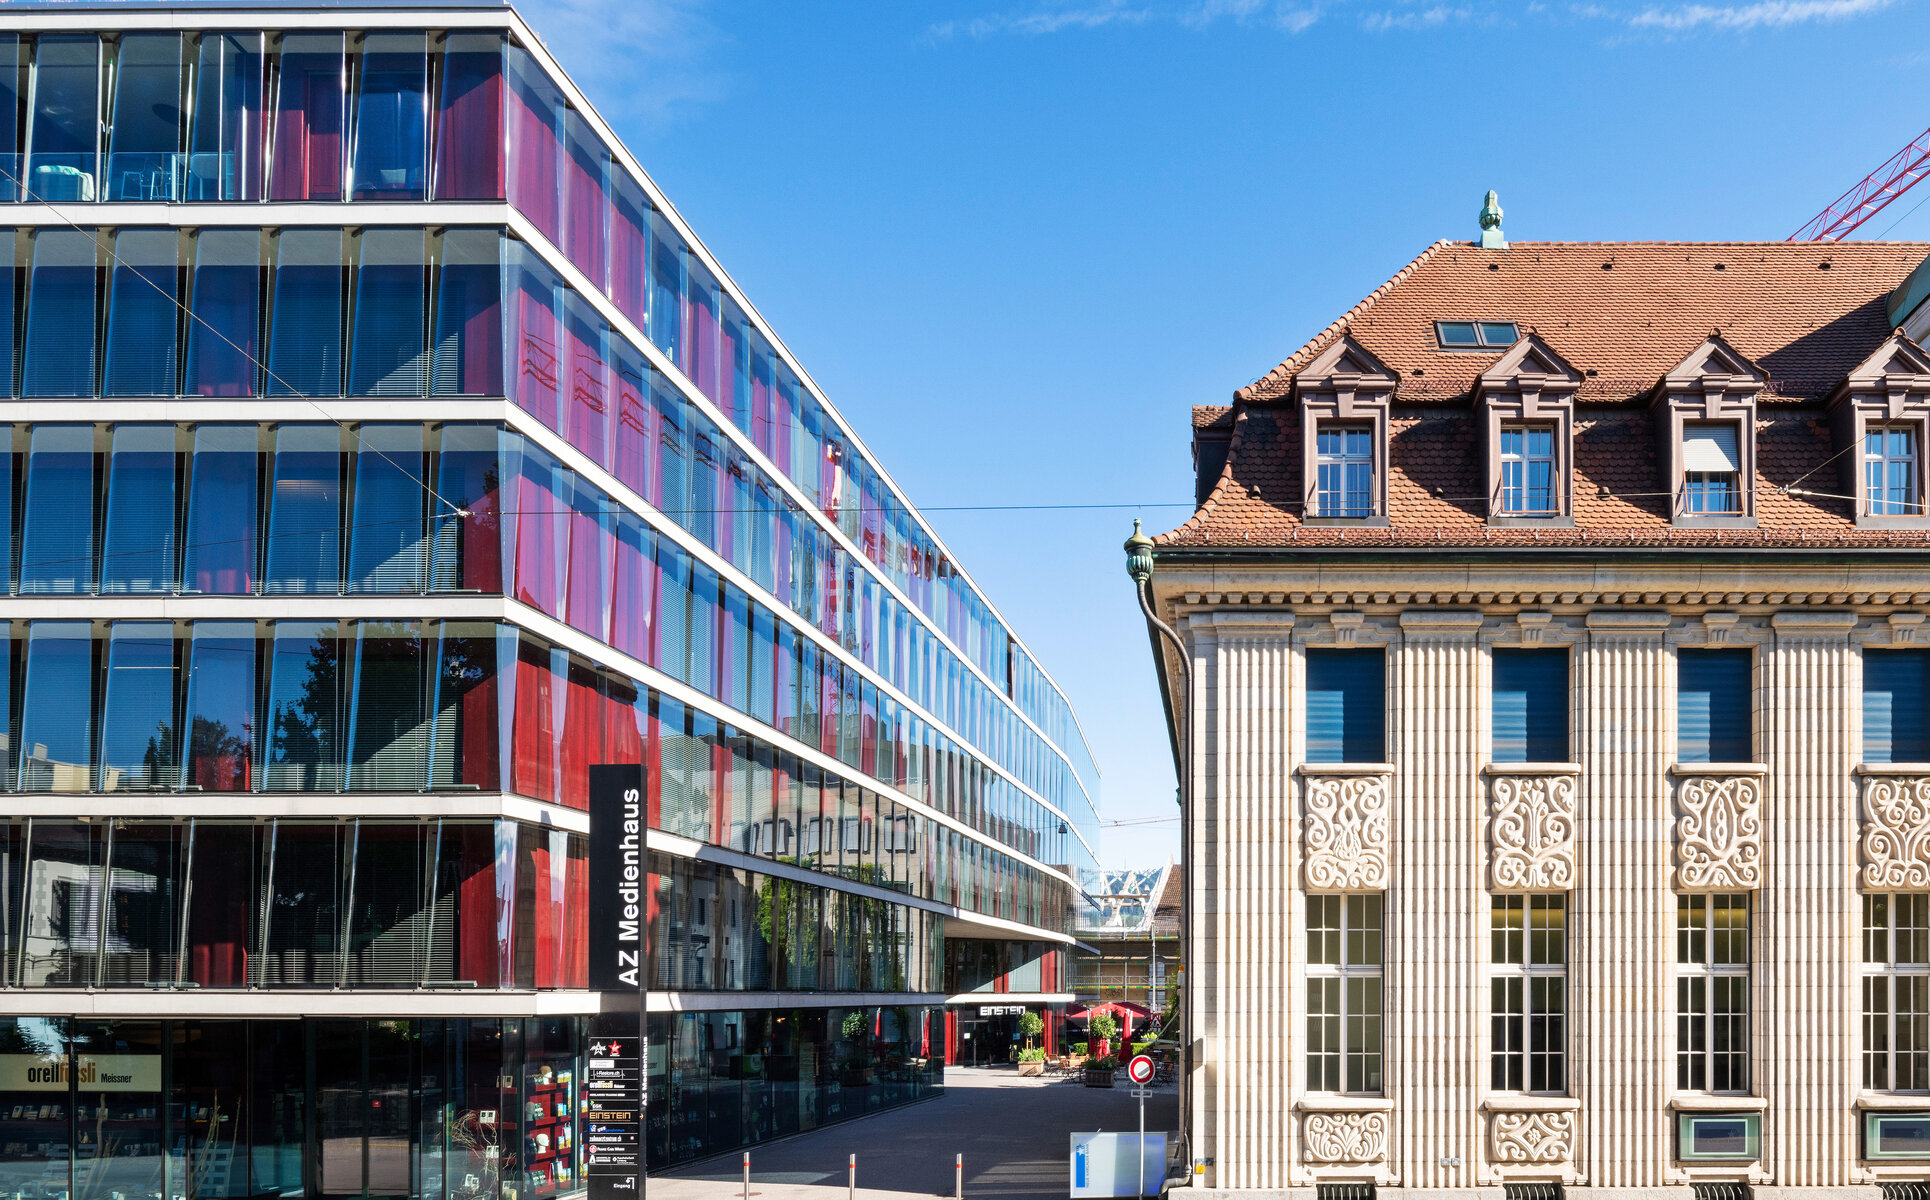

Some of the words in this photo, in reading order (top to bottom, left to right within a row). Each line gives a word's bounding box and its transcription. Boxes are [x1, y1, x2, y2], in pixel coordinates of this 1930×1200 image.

[619, 788, 639, 941] Medienhaus
[619, 950, 639, 987] AZ
[980, 1005, 1026, 1016] EINSTEIN
[100, 1073, 133, 1083] Meissner
[642, 1092, 648, 1106] AZ
[589, 1111, 631, 1119] EINSTEIN
